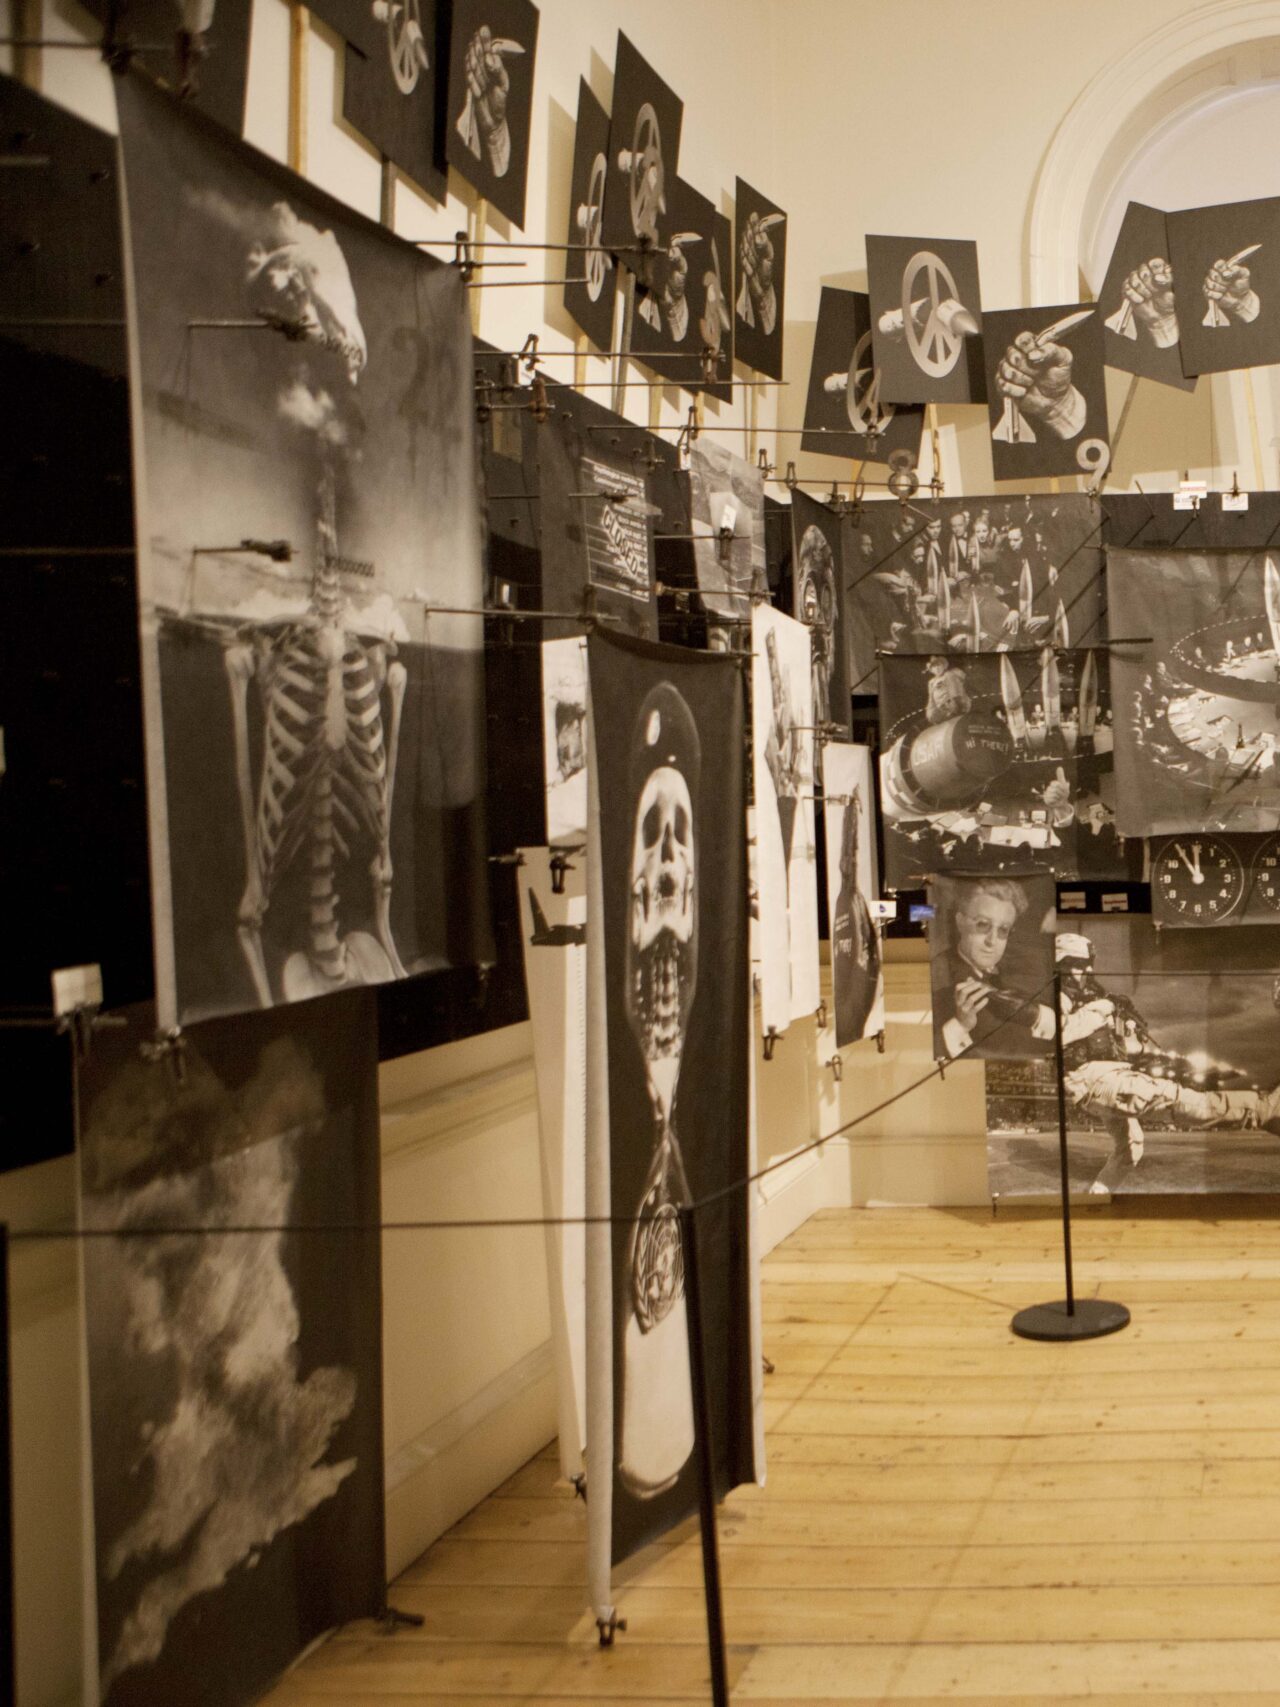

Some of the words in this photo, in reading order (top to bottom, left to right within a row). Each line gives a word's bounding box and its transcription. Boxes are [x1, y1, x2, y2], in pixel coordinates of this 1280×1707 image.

[1077, 438, 1110, 490] 9
[603, 509, 638, 575] CLOSED
[1167, 859, 1179, 869] 10
[1219, 859, 1227, 868] 2
[1265, 857, 1276, 866] 10
[1163, 874, 1171, 883] 9
[1224, 874, 1232, 883] 3
[1261, 872, 1269, 882] 9
[1168, 889, 1177, 899] 8
[1219, 888, 1227, 898] 4
[1267, 888, 1274, 897] 8
[1179, 900, 1187, 910] 7
[1194, 904, 1202, 913] 6
[1209, 900, 1217, 909] 5
